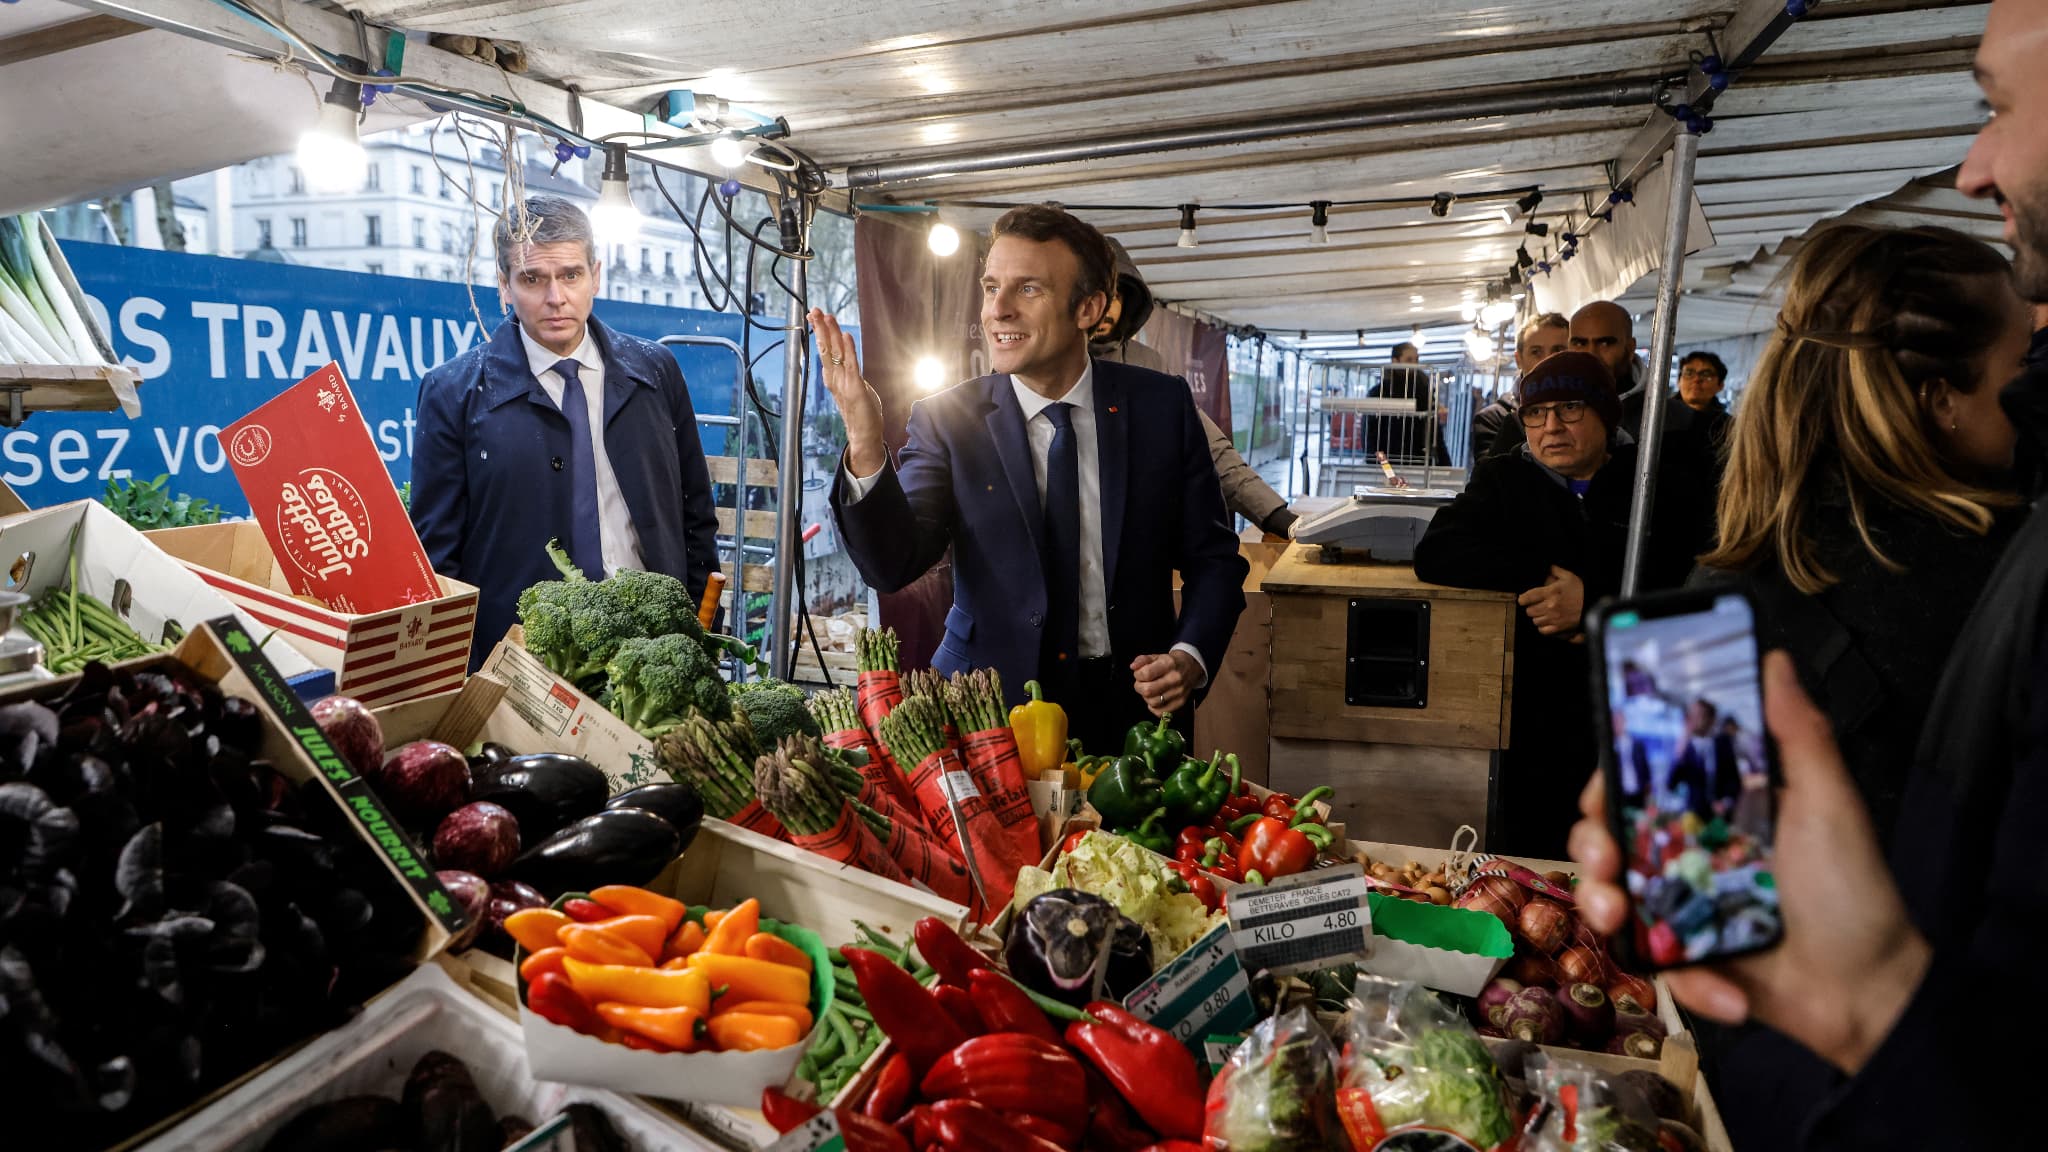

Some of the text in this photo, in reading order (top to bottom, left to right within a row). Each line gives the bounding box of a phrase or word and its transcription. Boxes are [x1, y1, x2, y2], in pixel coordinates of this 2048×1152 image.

[191, 301, 478, 381] TRAVAUX
[327, 373, 349, 411] BAYARD
[2, 428, 133, 487] sez
[281, 481, 353, 582] Juliette
[306, 473, 370, 560] Sables
[330, 529, 344, 545] des
[293, 726, 351, 781] JULES
[350, 795, 427, 880] NOURRIT
[1248, 886, 1322, 907] DEMETER FRANCE
[1249, 888, 1351, 914] BETTERAVES CRUES CAT2
[1254, 911, 1357, 944] KILO 4.80
[1203, 986, 1230, 1018] 9.80
